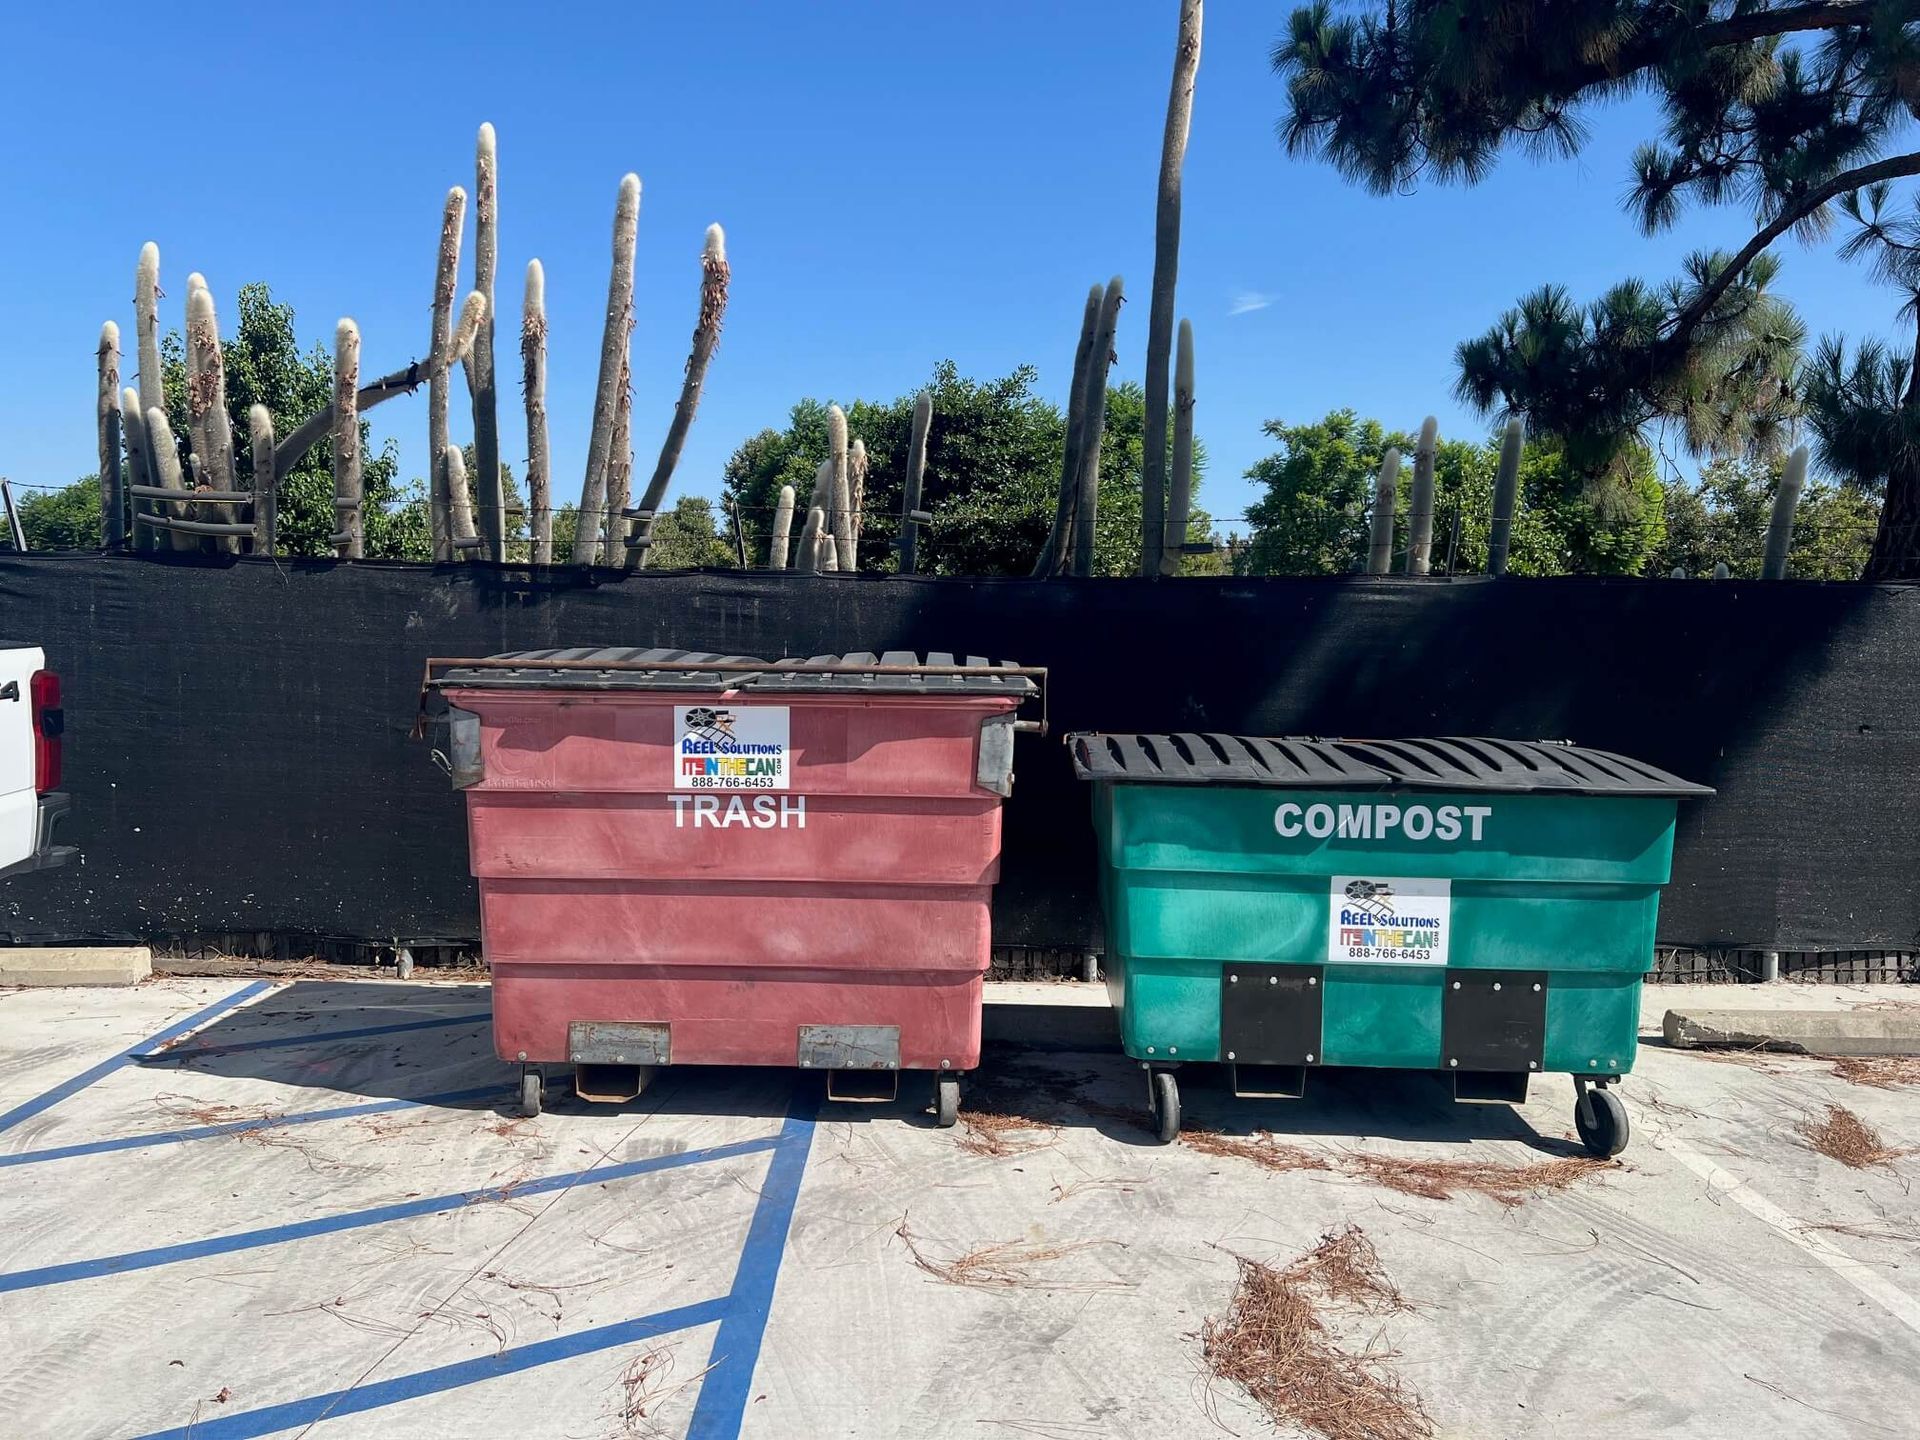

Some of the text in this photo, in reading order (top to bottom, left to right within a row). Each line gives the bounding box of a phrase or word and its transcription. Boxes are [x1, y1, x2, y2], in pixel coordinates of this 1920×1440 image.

[692, 777, 774, 788] 888-766-6453
[667, 794, 806, 829] TRASH
[1274, 803, 1492, 841] COMPOST
[1349, 947, 1430, 960] 888-766-6453
